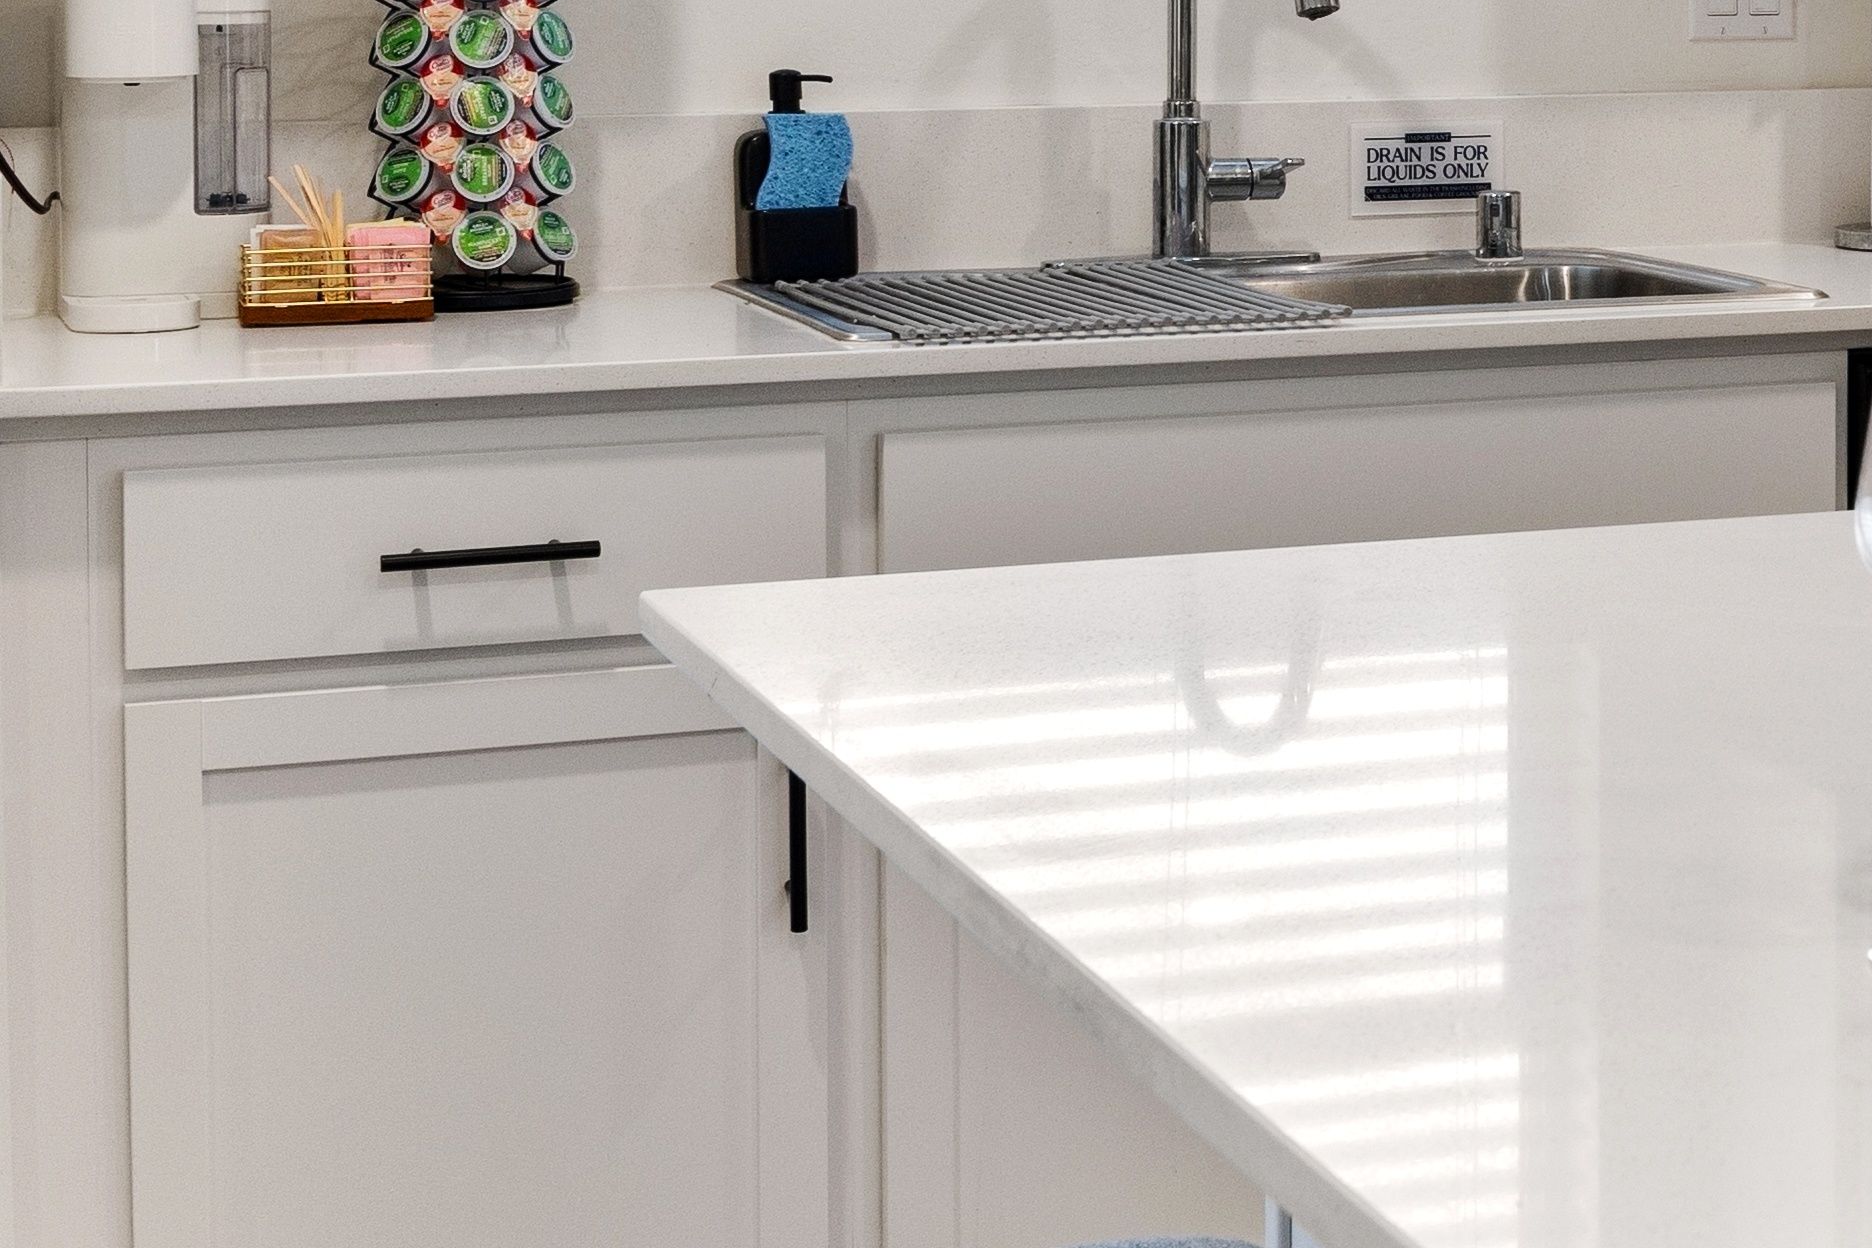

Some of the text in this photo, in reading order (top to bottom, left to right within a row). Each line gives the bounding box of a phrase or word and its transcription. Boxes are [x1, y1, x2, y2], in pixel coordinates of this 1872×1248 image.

[1366, 145, 1489, 163] DRAIN IS FOR
[1367, 162, 1489, 183] LIQUIDS ONLY
